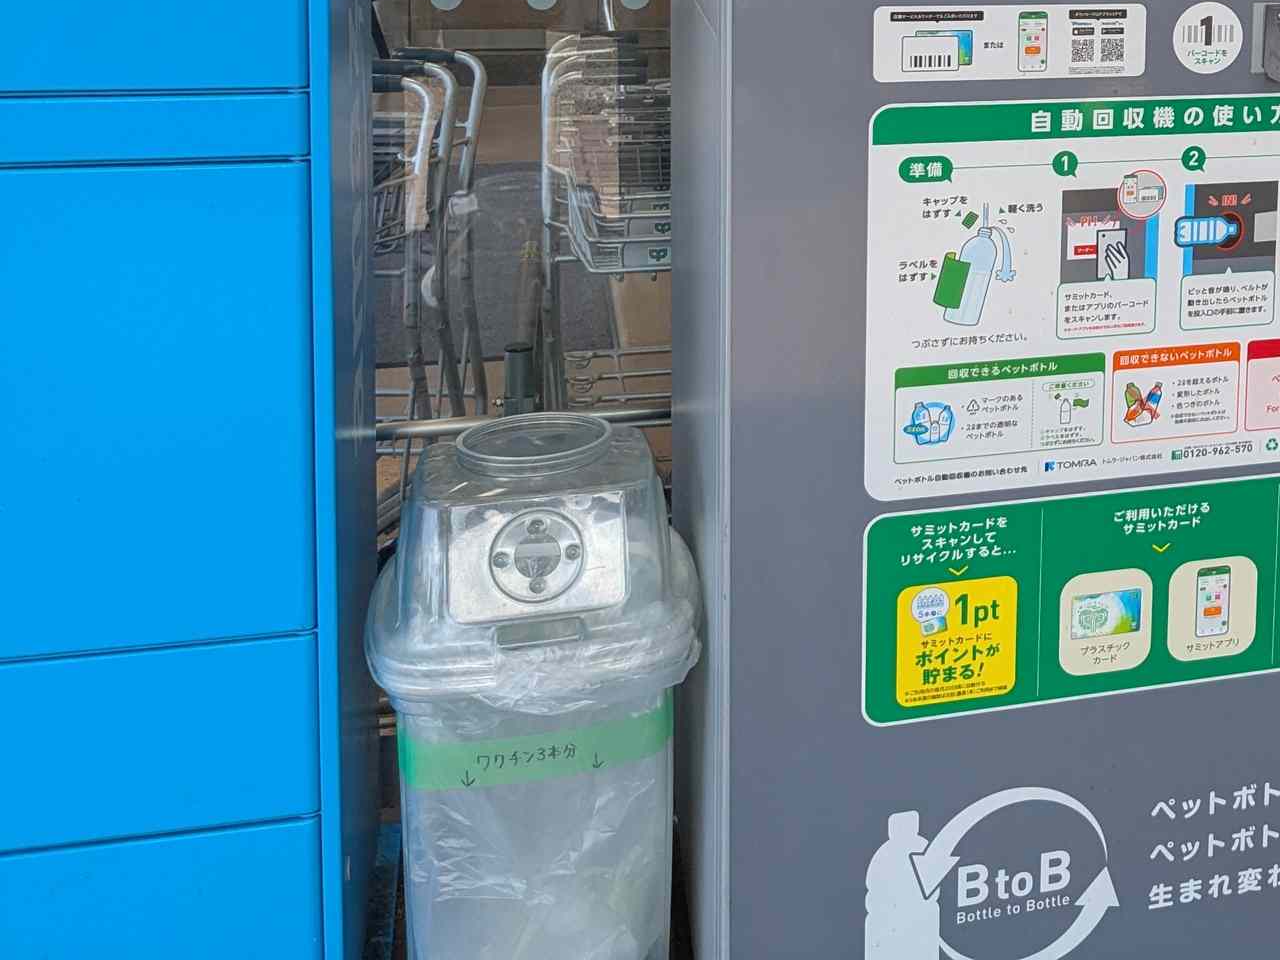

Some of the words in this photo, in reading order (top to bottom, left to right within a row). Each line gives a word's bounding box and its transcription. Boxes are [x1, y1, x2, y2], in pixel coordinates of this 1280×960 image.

[1200, 16, 1213, 47] 1
[1187, 48, 1227, 58] バーコードを
[1194, 56, 1221, 65] スキャン
[1061, 155, 1069, 171] 1
[1188, 151, 1199, 167] 2
[909, 161, 943, 178] 準備
[922, 196, 968, 206] キャップを
[1007, 203, 1043, 214] 軽く洗う
[922, 209, 951, 219] はずす
[898, 259, 938, 270] ラベルを
[898, 272, 928, 283] はずす
[1064, 300, 1149, 312] またはアプリのバーコード
[911, 332, 1028, 350] つぶさずにお持ちください。
[1119, 348, 1232, 366] 回収できないペットボトル
[948, 362, 1058, 380] 回収できるペットボトル
[1266, 404, 1279, 413] For
[1183, 443, 1253, 458] 0120-962-570
[1057, 458, 1097, 471] TOMRA
[1113, 501, 1211, 522] ご利用いただける
[911, 517, 1008, 537] サミットカードを
[1123, 518, 1201, 535] サミットカード
[921, 531, 996, 550] スキャンして
[955, 593, 1000, 628] 1pt
[921, 633, 992, 648] サミットカードに
[1080, 640, 1130, 656] プラスチック
[1186, 638, 1240, 653] サミットアプリ
[915, 643, 1000, 667] ポイントが
[1092, 653, 1118, 665] カード
[923, 662, 984, 685] 貯まる!
[956, 906, 1002, 925] Bottle
[1006, 903, 1022, 916] to
[1026, 894, 1071, 913] Bottle
